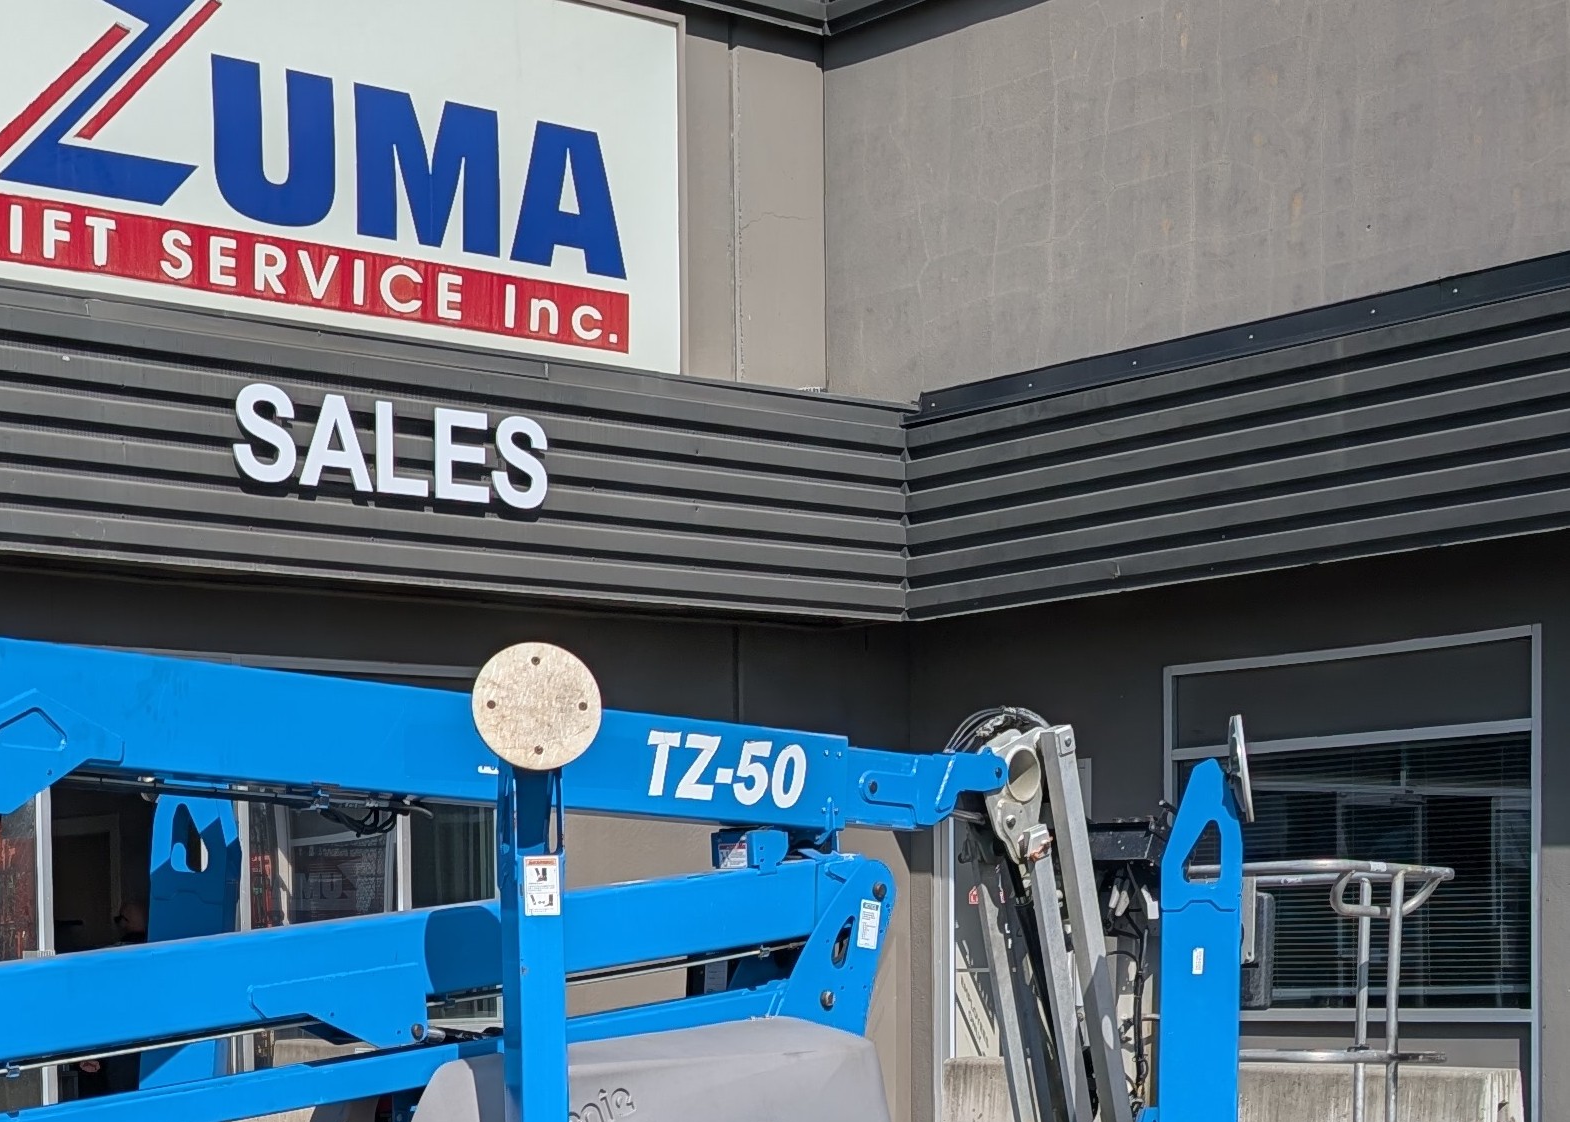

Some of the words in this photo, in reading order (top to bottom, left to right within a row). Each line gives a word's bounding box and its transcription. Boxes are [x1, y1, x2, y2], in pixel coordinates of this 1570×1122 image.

[159, 229, 464, 322] SERVICE
[504, 283, 619, 344] Inc.
[233, 383, 549, 510] SALES
[647, 730, 807, 809] TZ-50
